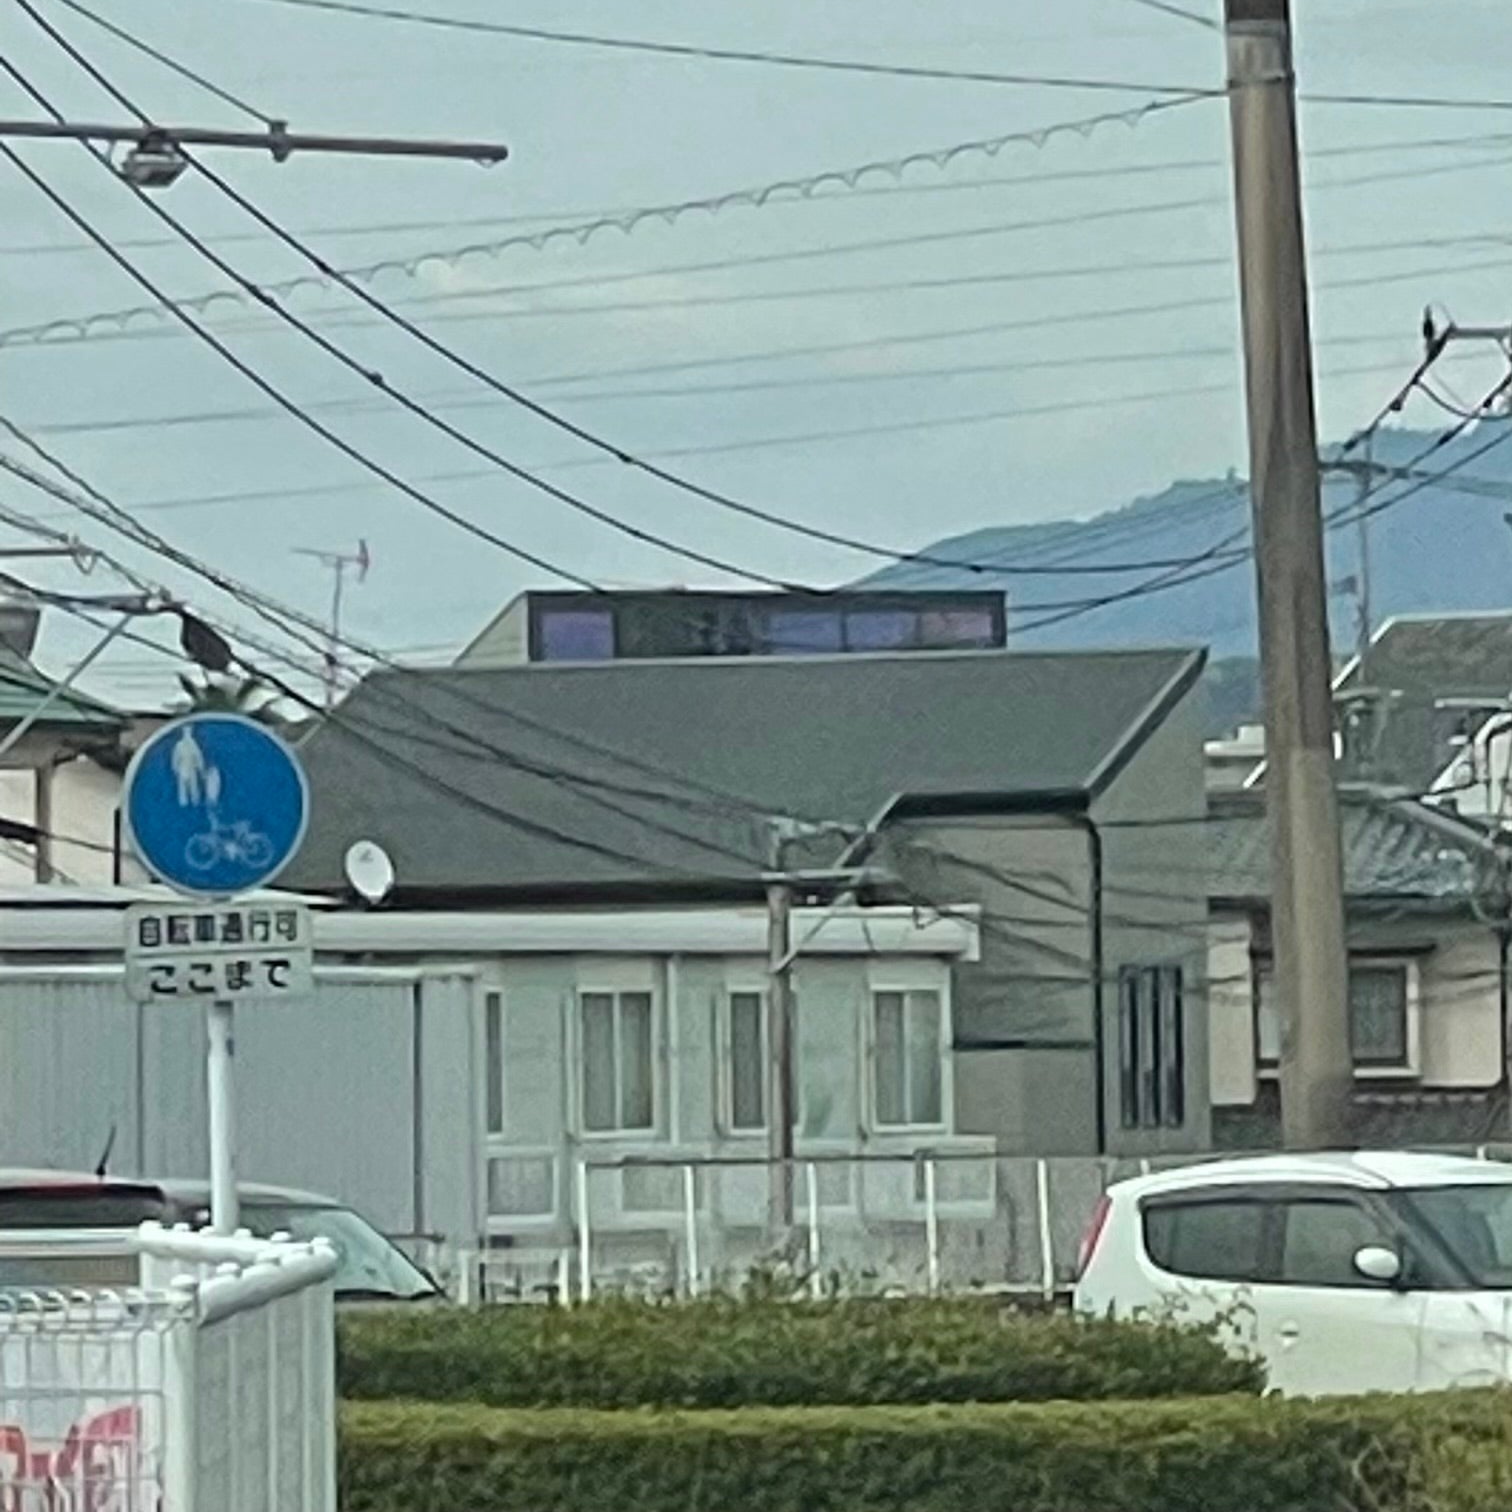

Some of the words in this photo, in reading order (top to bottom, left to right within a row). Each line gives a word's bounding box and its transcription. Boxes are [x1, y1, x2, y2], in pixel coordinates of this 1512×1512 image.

[138, 908, 298, 947] 自転車通行可
[150, 959, 291, 994] ここまで
